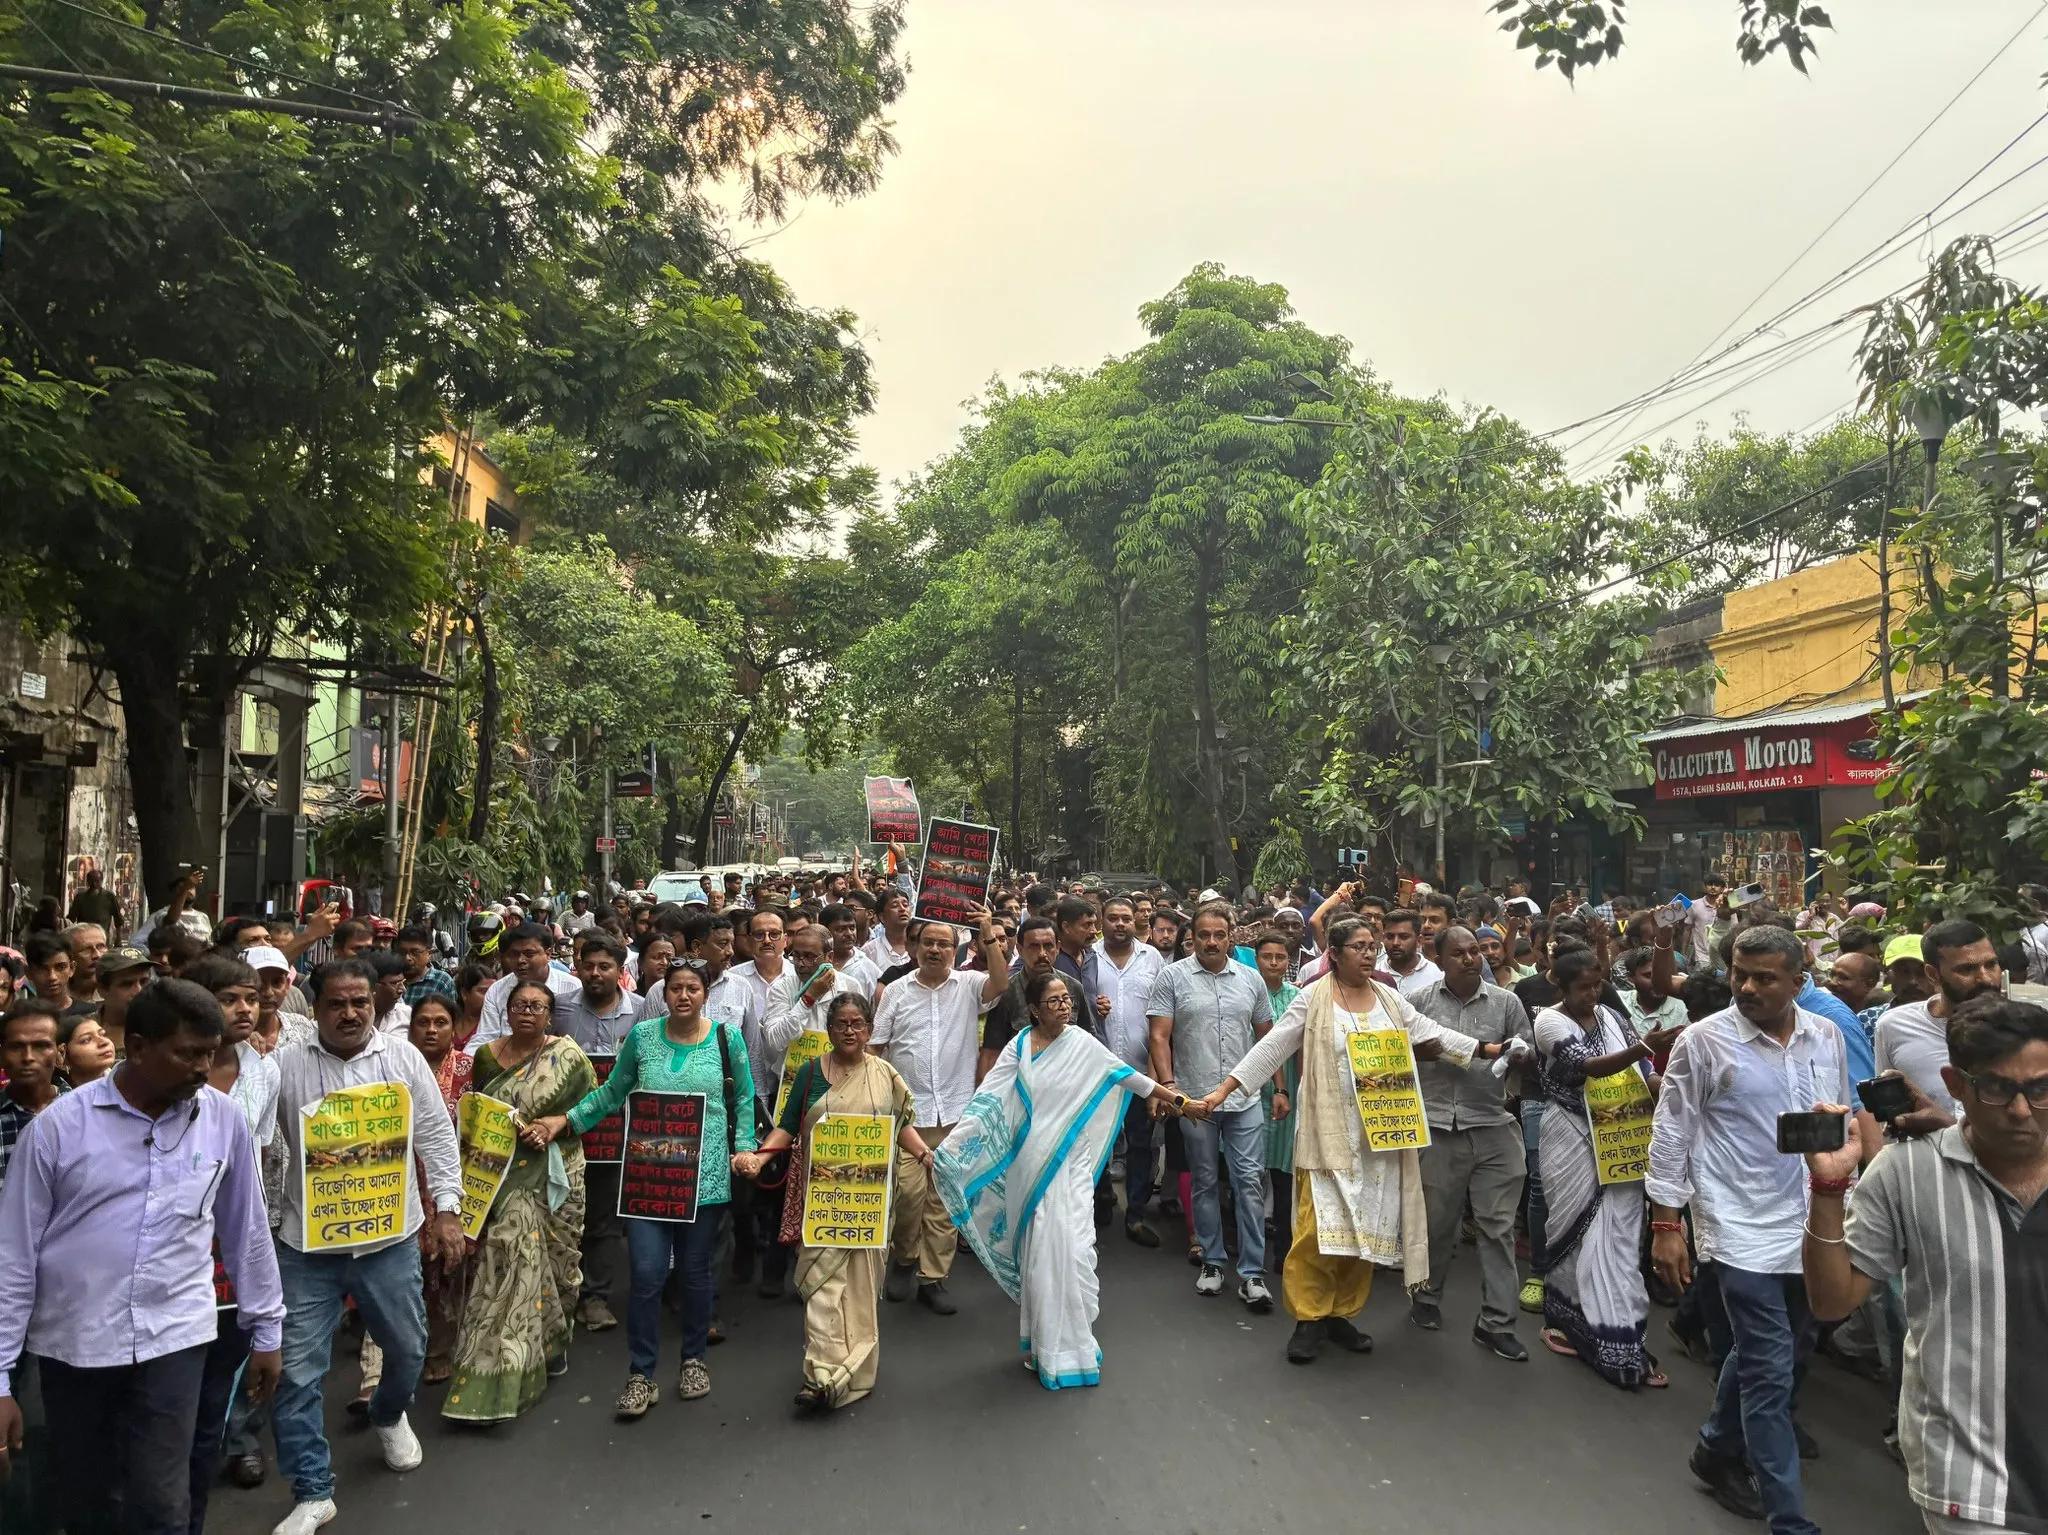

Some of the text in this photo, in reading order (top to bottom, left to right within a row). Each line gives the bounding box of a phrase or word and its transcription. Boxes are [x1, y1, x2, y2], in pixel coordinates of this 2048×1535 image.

[1656, 736, 1813, 781] CALCUTTA MOTOR
[1672, 786, 1692, 797] 157A,
[1692, 784, 1715, 795] LENIN
[1716, 780, 1747, 792] SARANI,
[1748, 778, 1786, 790] KOLKATA
[1792, 774, 1803, 785] 13
[936, 826, 960, 840] আমি
[924, 905, 969, 922] বেকা
[1354, 1034, 1381, 1052] আমি
[1354, 1055, 1387, 1070] খাওয়া
[319, 1090, 400, 1117] আমি খেটে
[1361, 1095, 1392, 1113] বিজেপির
[310, 1114, 404, 1140] খাওয়া হকার
[820, 1120, 882, 1140] আমি খেটে
[1372, 1128, 1418, 1146] বেকার
[480, 1128, 513, 1151] হকার
[815, 1142, 886, 1160] খাওয়া হকার
[1608, 1157, 1650, 1178] বেকা
[312, 1172, 401, 1198] বিজেপির আমলে
[311, 1192, 400, 1220] এখন উচ্ছেদ হওয়া
[812, 1186, 882, 1206] বিজেপির আমলে
[628, 1199, 687, 1216] বেকার
[808, 1208, 881, 1225] এখন উচ্ছেদ হওয়া
[322, 1213, 394, 1241] বেকার
[814, 1225, 875, 1242] বেকার
